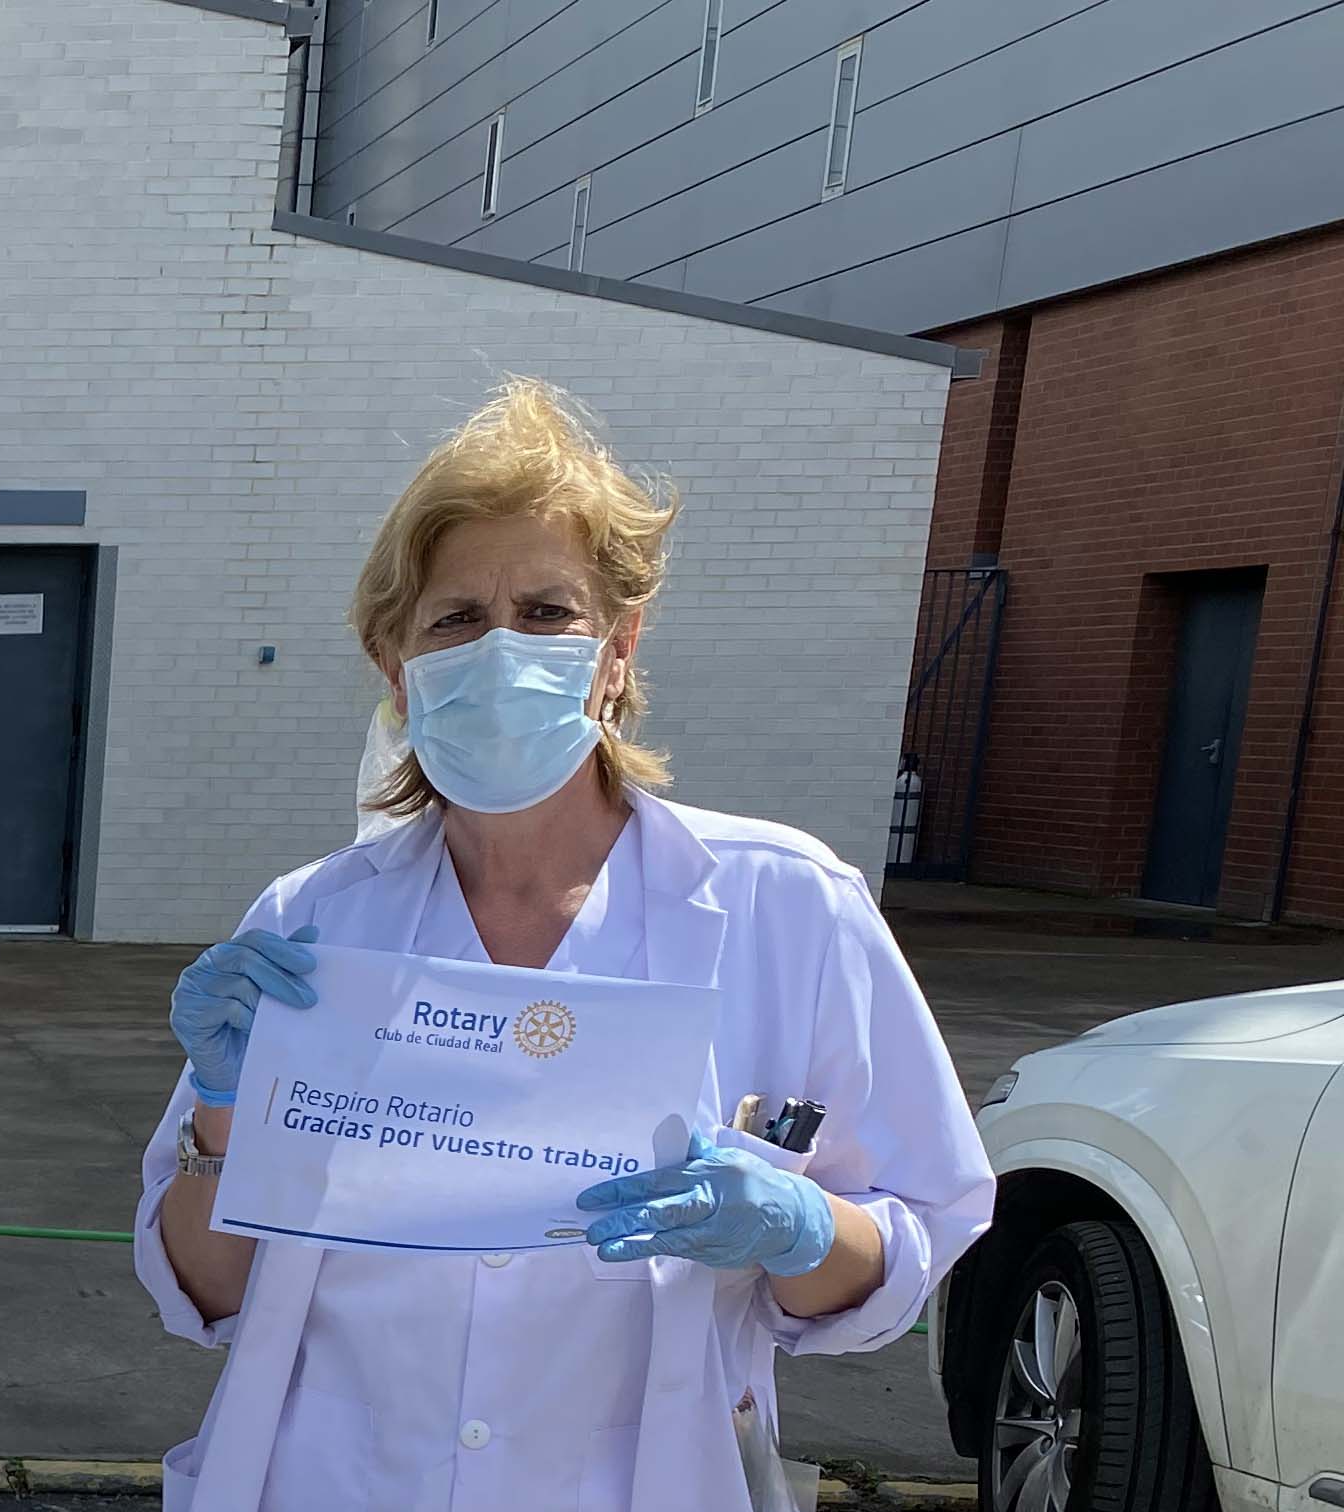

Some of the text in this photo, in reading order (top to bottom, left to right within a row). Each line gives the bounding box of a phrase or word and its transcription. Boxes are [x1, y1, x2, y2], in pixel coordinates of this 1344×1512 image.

[375, 1028, 503, 1053] Club de Ciudad Real
[413, 1001, 508, 1039] Rotary
[289, 1080, 473, 1127] Respiro Rotario
[284, 1108, 639, 1176] Gracias por vuestro trabajo
